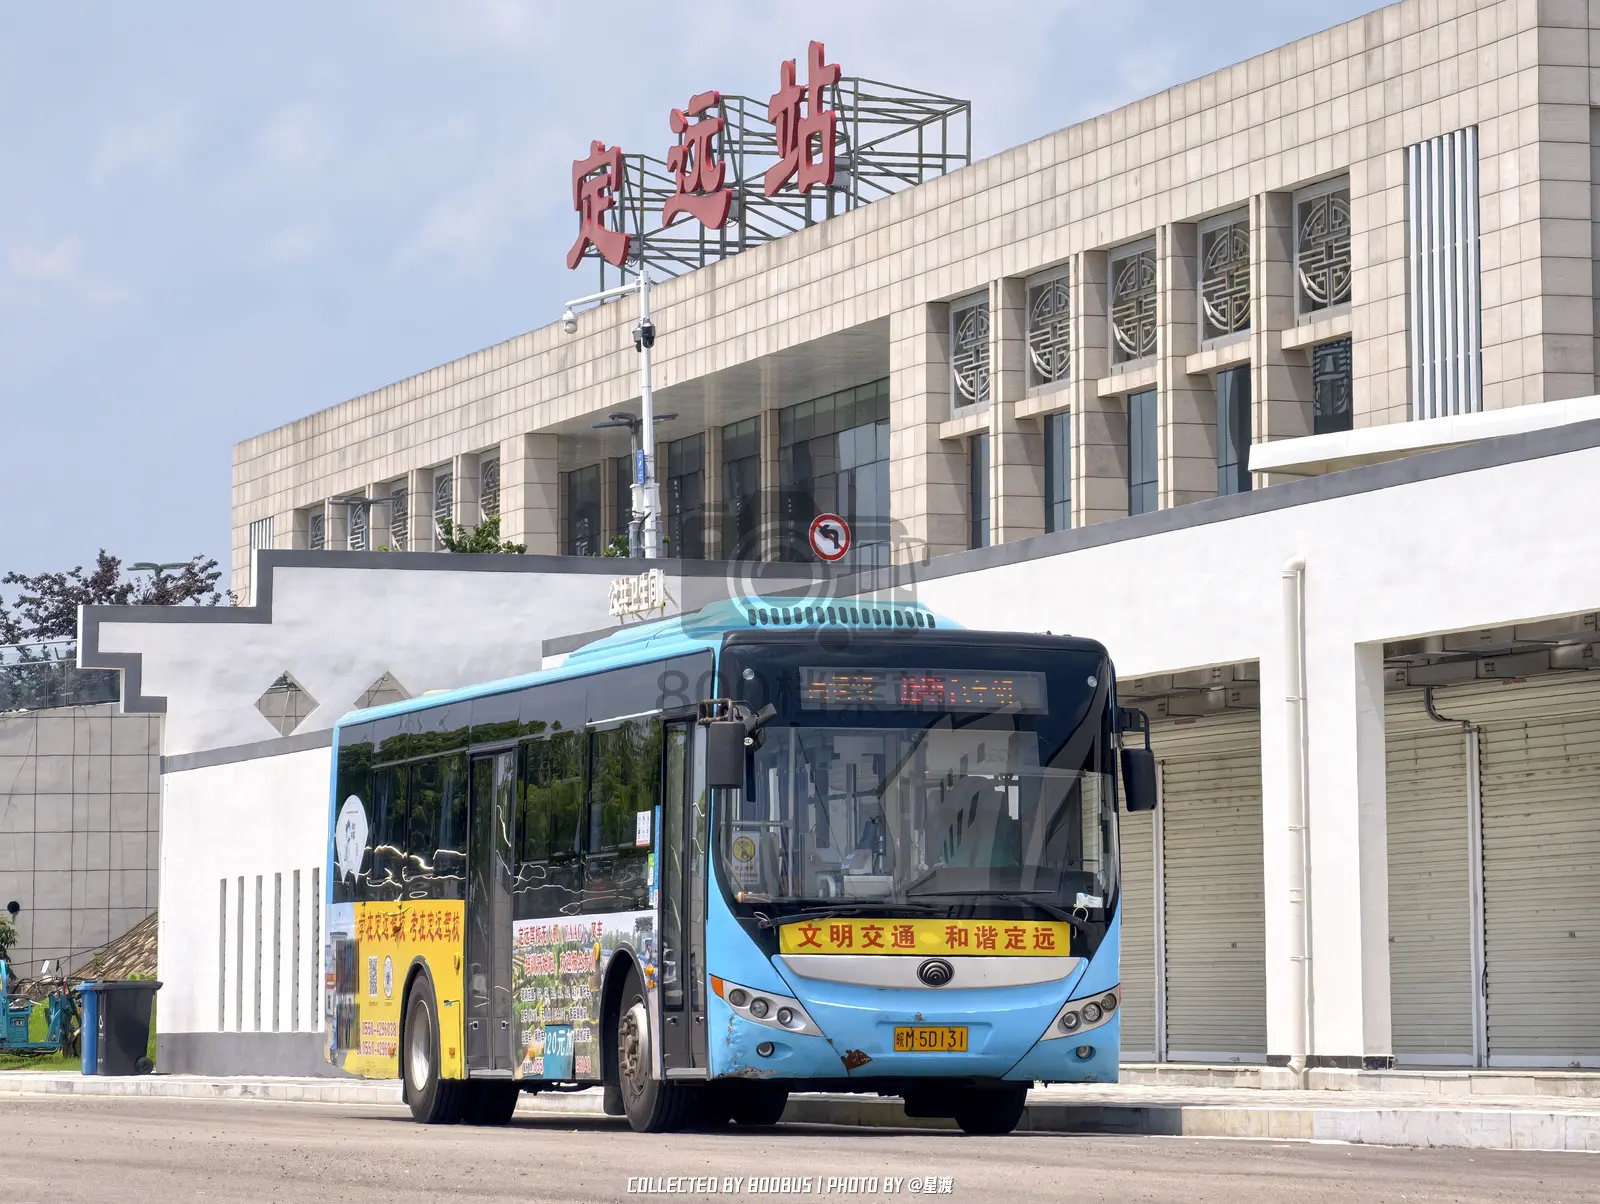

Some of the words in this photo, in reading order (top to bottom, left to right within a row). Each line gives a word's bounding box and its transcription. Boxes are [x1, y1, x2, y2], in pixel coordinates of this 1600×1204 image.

[566, 40, 841, 270] 定远站
[797, 923, 916, 949] 文明交通
[945, 924, 1056, 951] 和谐定远
